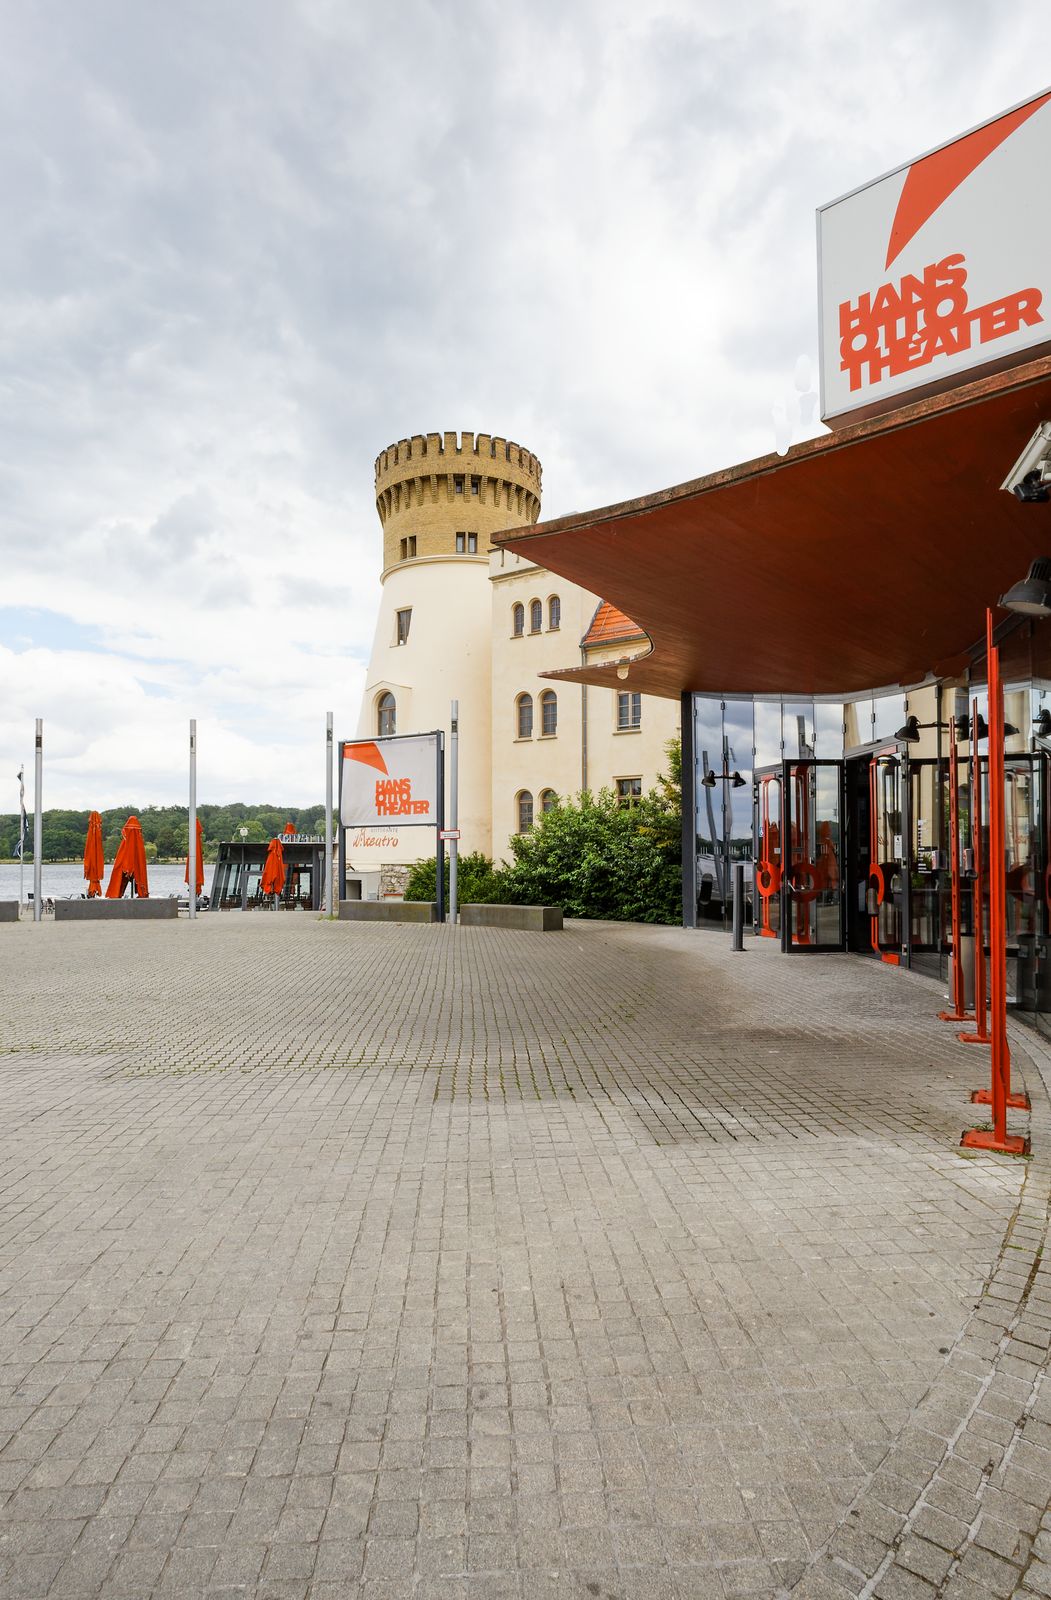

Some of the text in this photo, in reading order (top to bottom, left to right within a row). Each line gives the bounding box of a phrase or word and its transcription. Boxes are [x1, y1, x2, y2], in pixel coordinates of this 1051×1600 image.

[839, 253, 968, 338] HANS
[840, 285, 969, 362] OTTO
[840, 287, 1045, 392] THEATER
[375, 778, 411, 794] HANS
[375, 790, 411, 806] OTTO
[375, 800, 430, 816] THEATER
